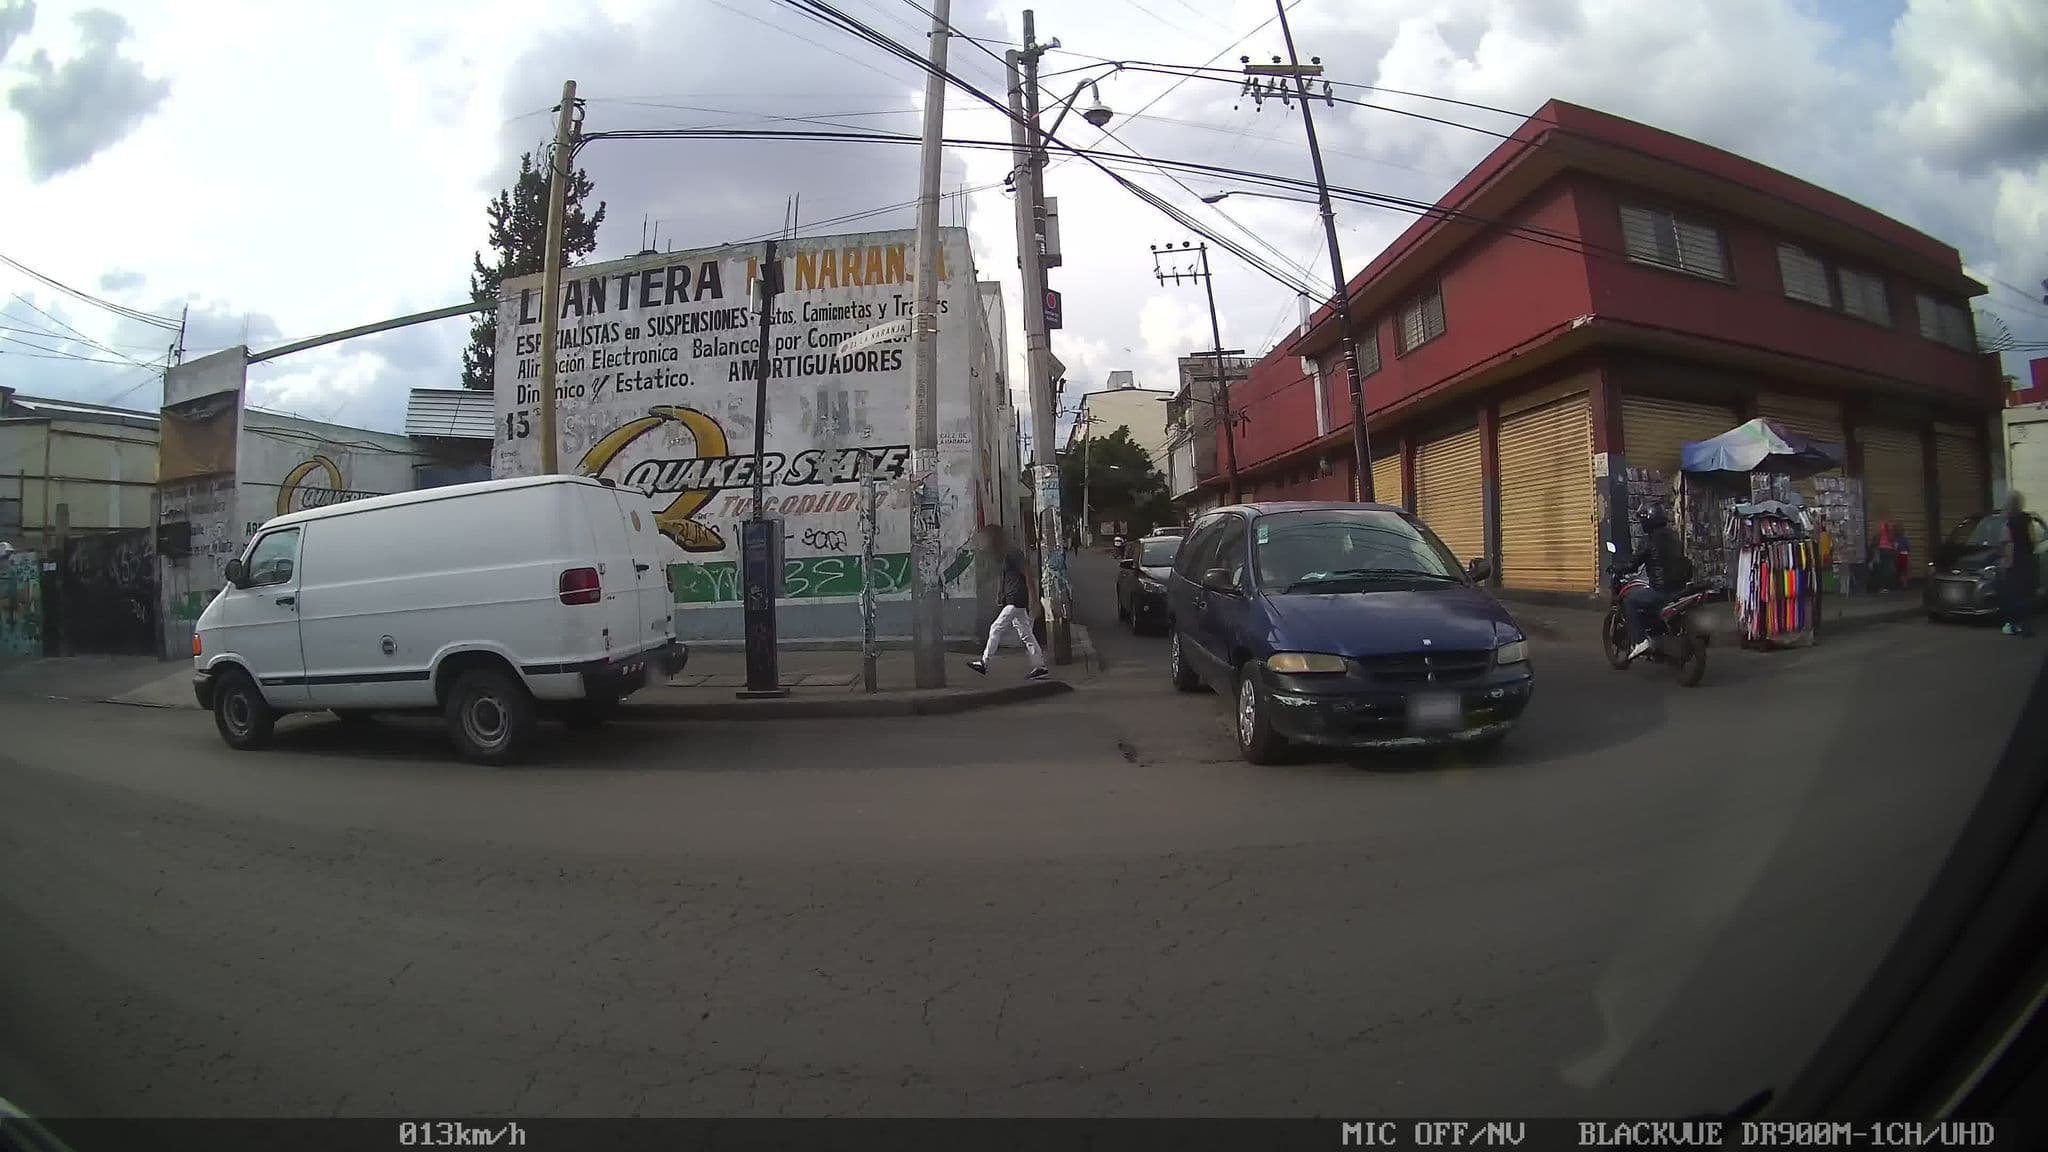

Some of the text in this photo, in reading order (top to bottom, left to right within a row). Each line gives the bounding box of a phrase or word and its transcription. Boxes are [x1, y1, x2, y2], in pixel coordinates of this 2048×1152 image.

[519, 260, 723, 326] LANTERA
[795, 243, 947, 291] NARAN
[516, 322, 620, 356] ESPCIALISTAS
[625, 325, 640, 340] en
[877, 302, 888, 319] y
[871, 324, 906, 340] NARANJA
[592, 343, 678, 371] Electronica
[776, 335, 801, 356] por
[728, 349, 902, 382] AMRTIGUADORES
[517, 380, 585, 405] Dinmico
[616, 368, 695, 394] Estatico.
[506, 410, 530, 440] 15
[624, 452, 785, 498] QUAKER
